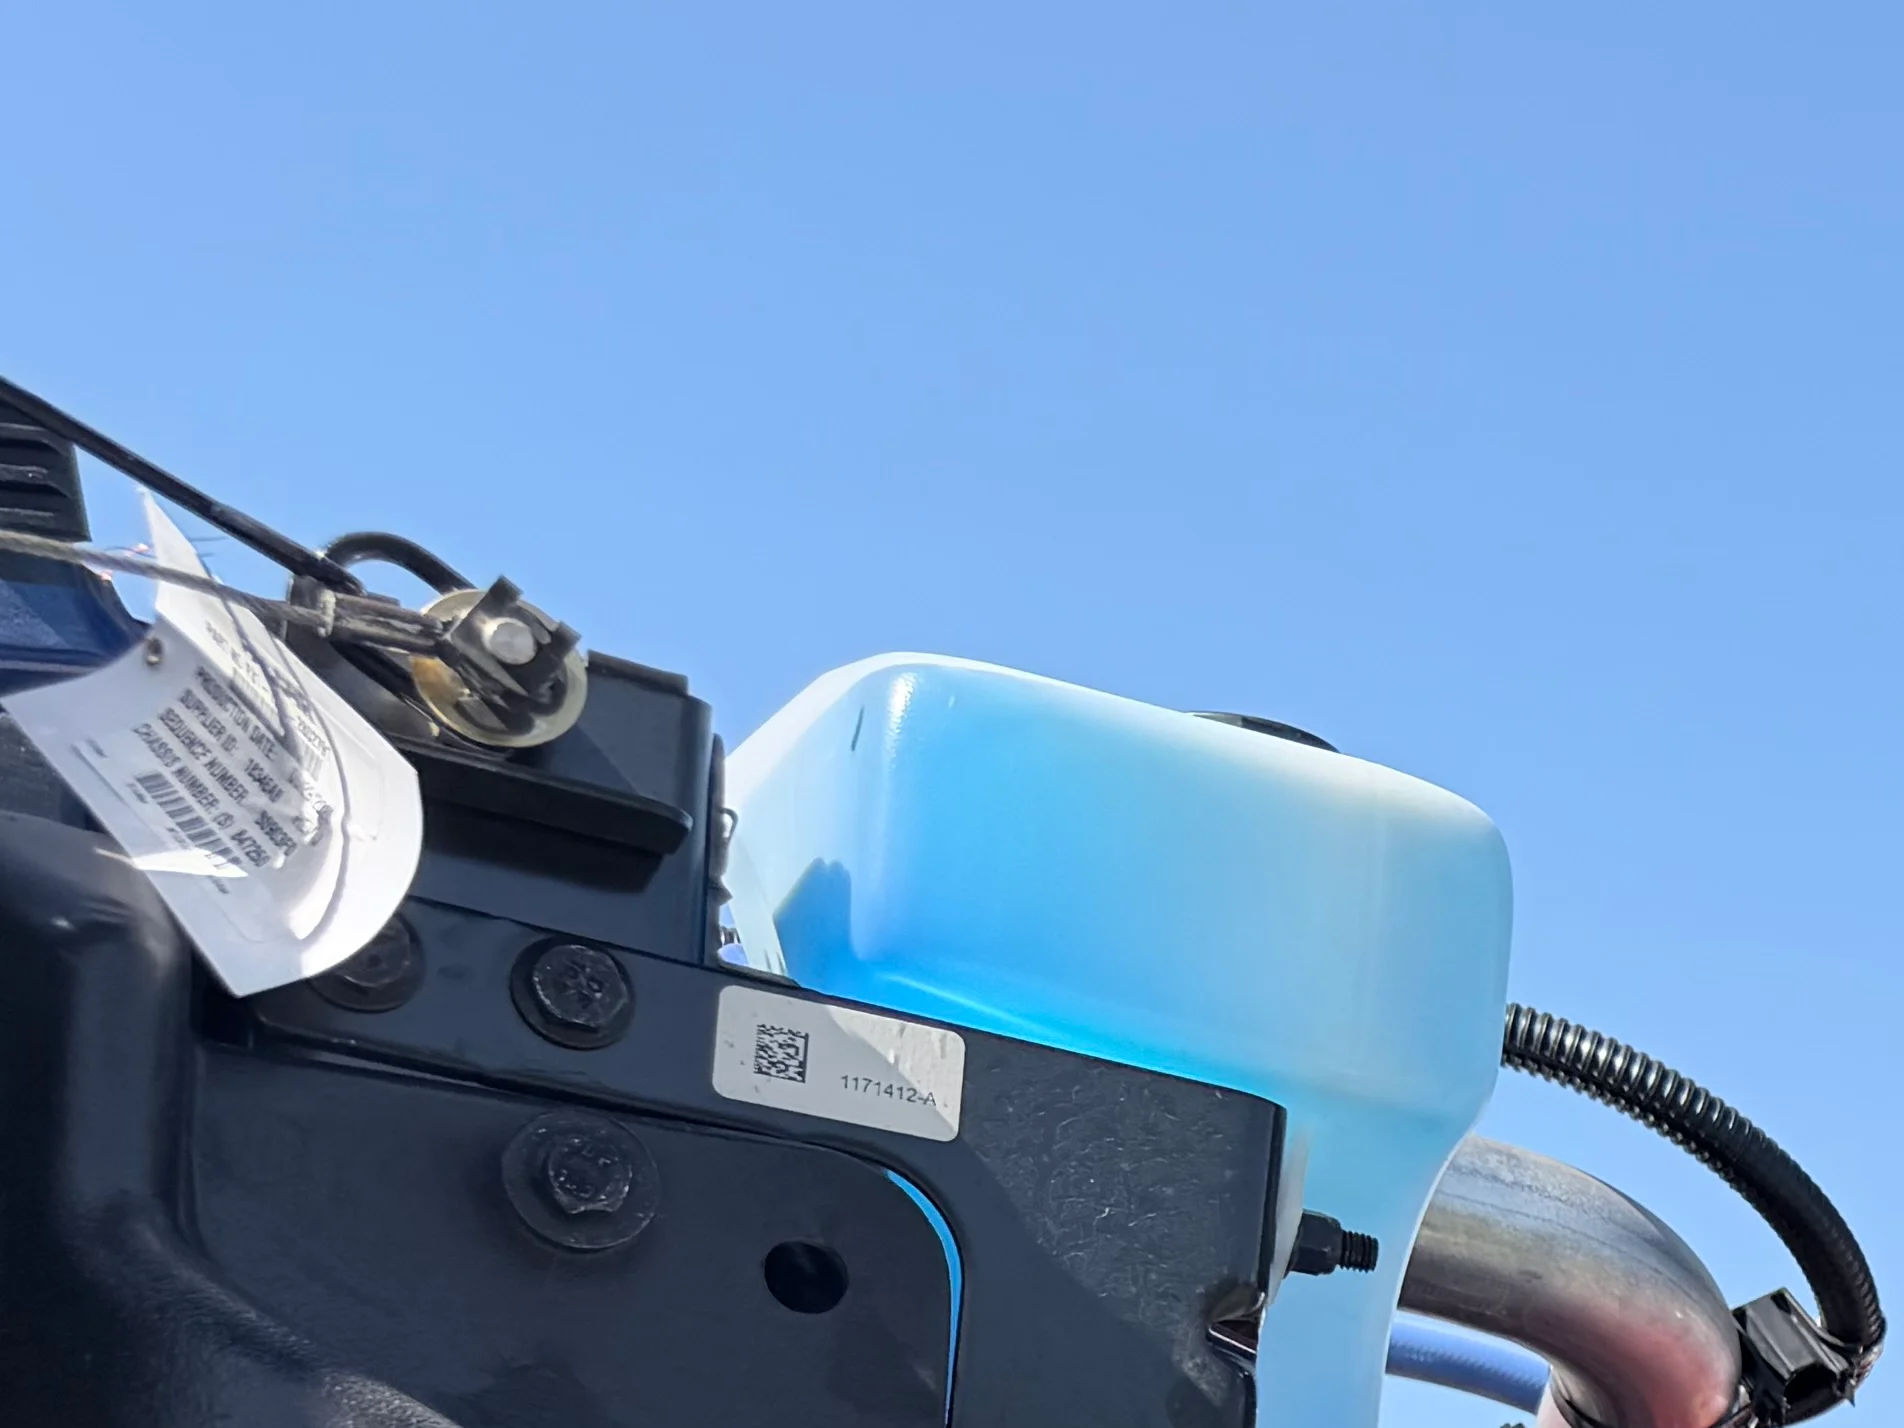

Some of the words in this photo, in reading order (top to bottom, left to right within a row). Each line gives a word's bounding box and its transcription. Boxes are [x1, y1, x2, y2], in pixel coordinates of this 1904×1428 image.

[158, 708, 211, 772] SEQUENCE
[179, 688, 227, 748] SUPPLIER
[131, 722, 180, 770] CHASSIS
[841, 1074, 937, 1107] 1171412-A
